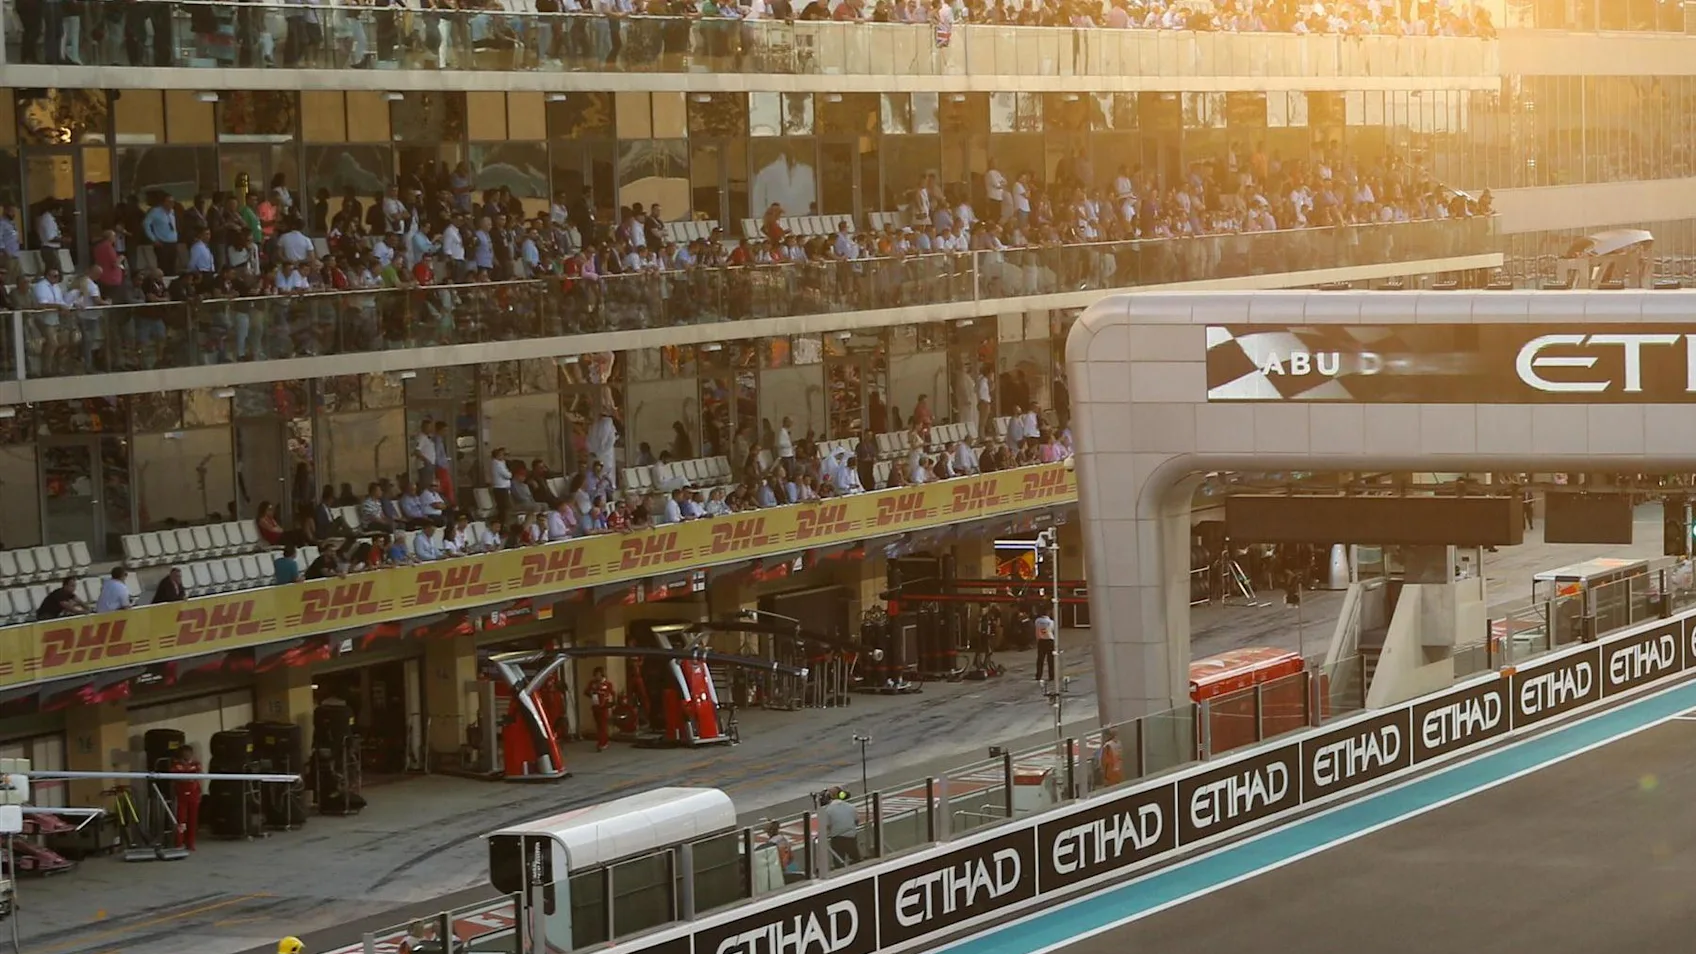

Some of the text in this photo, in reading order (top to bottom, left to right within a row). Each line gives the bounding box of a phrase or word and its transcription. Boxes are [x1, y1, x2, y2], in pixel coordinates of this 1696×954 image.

[1263, 351, 1340, 376] ABU
[951, 479, 1001, 513] DHL
[1022, 468, 1068, 500] DHL
[797, 503, 852, 540] DHL
[877, 491, 931, 527] DHL
[620, 531, 684, 571] DHL
[711, 518, 769, 555] DHL
[415, 564, 489, 605] DHL
[521, 547, 590, 588] DHL
[176, 600, 261, 646] DHL
[301, 581, 380, 625] DHL
[42, 619, 133, 668] DHL
[1609, 634, 1675, 685] ETIHAD
[1520, 661, 1592, 715] ETIHAD
[1422, 691, 1501, 749] ETIHAD
[1313, 724, 1401, 787] ETIHAD
[1190, 761, 1288, 829] ETIHAD
[1052, 803, 1163, 875] ETIHAD
[895, 847, 1021, 927] ETIHAD
